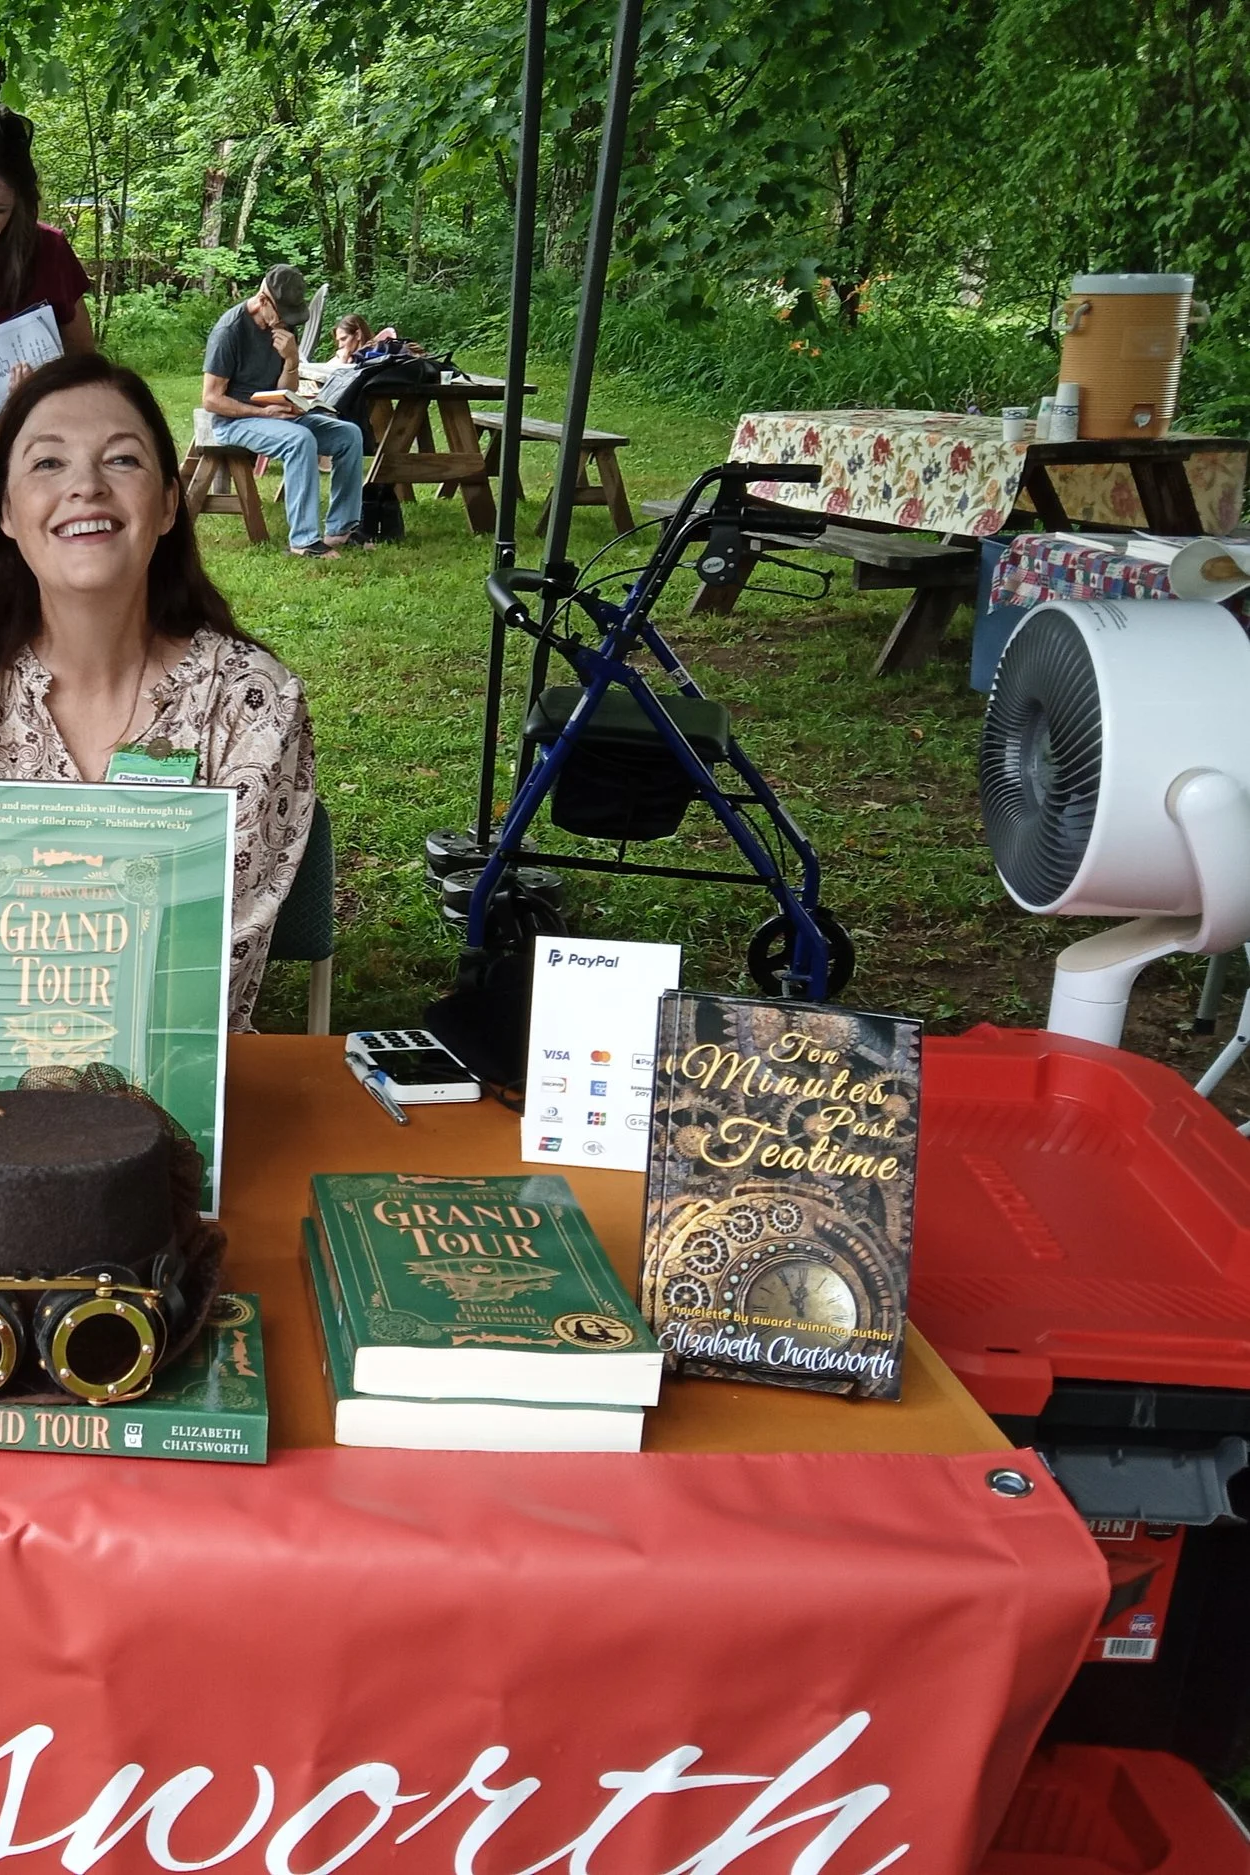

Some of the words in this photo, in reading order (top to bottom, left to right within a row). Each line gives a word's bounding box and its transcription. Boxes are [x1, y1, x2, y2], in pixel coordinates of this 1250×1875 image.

[118, 774, 149, 783] Elizabeth
[149, 776, 185, 784] Chatsworth
[2, 801, 19, 810] and
[20, 803, 40, 811] new
[41, 803, 74, 812] readers
[75, 804, 97, 813] alike
[98, 804, 117, 813] will
[117, 806, 136, 814] tear
[136, 805, 173, 817] through
[175, 807, 193, 816] this
[16, 815, 66, 826] twist-filled
[156, 820, 191, 832] Weekly
[0, 902, 129, 955] GRAND
[568, 953, 620, 968] PayPal
[12, 956, 111, 1007] TOUR
[542, 1049, 571, 1060] VISA
[769, 1032, 840, 1065] Ten
[681, 1043, 890, 1105] Minutes
[817, 1106, 896, 1140] Past
[700, 1117, 900, 1181] Teatime
[386, 1191, 407, 1200] THE
[414, 1192, 454, 1200] BRASS
[456, 1192, 496, 1201] QUEEN
[373, 1200, 542, 1229] GRAND
[400, 1227, 542, 1258] TOUR
[455, 1312, 548, 1325] Chatsworth
[458, 1303, 537, 1315] Elizabeth
[661, 1305, 669, 1314] a
[672, 1306, 730, 1321] novelette
[733, 1313, 749, 1326] by
[752, 1316, 848, 1338] award-winning
[852, 1327, 894, 1342] author
[657, 1322, 761, 1363] Elizabeth
[766, 1335, 895, 1380] Chatsworth
[34, 1411, 111, 1450] TOUR
[171, 1425, 242, 1441] ELIZABETH
[162, 1438, 249, 1456] CHATSWORTH
